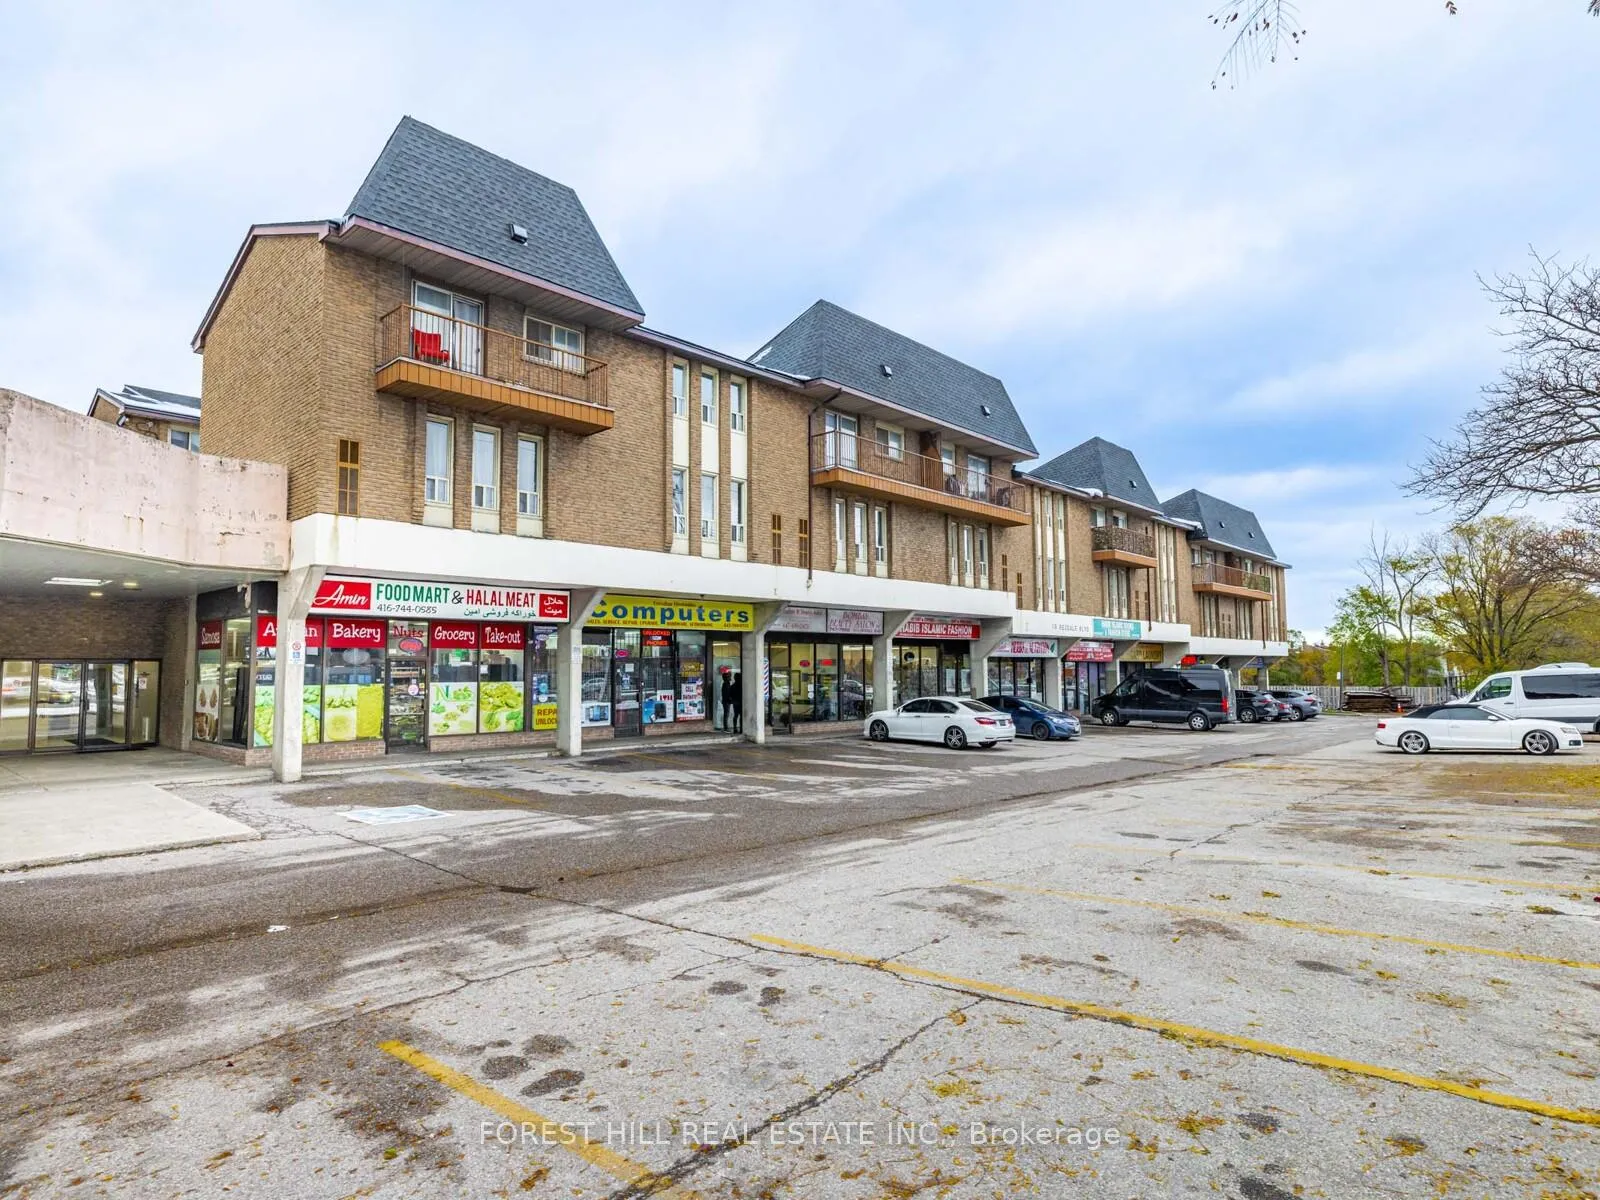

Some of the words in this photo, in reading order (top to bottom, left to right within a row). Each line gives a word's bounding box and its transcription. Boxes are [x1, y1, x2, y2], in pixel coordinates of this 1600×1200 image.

[314, 584, 369, 606] Amin
[451, 590, 464, 605] &
[543, 596, 564, 606] حلال
[376, 604, 438, 614] 416-744-0585
[591, 599, 749, 624] Computers
[332, 623, 381, 643] Bakery
[392, 625, 424, 638] Nuts
[434, 626, 475, 644] Grocery
[485, 626, 521, 644] Take-out
[921, 623, 947, 634] ISLAMIC
[947, 624, 973, 635] FASHION
